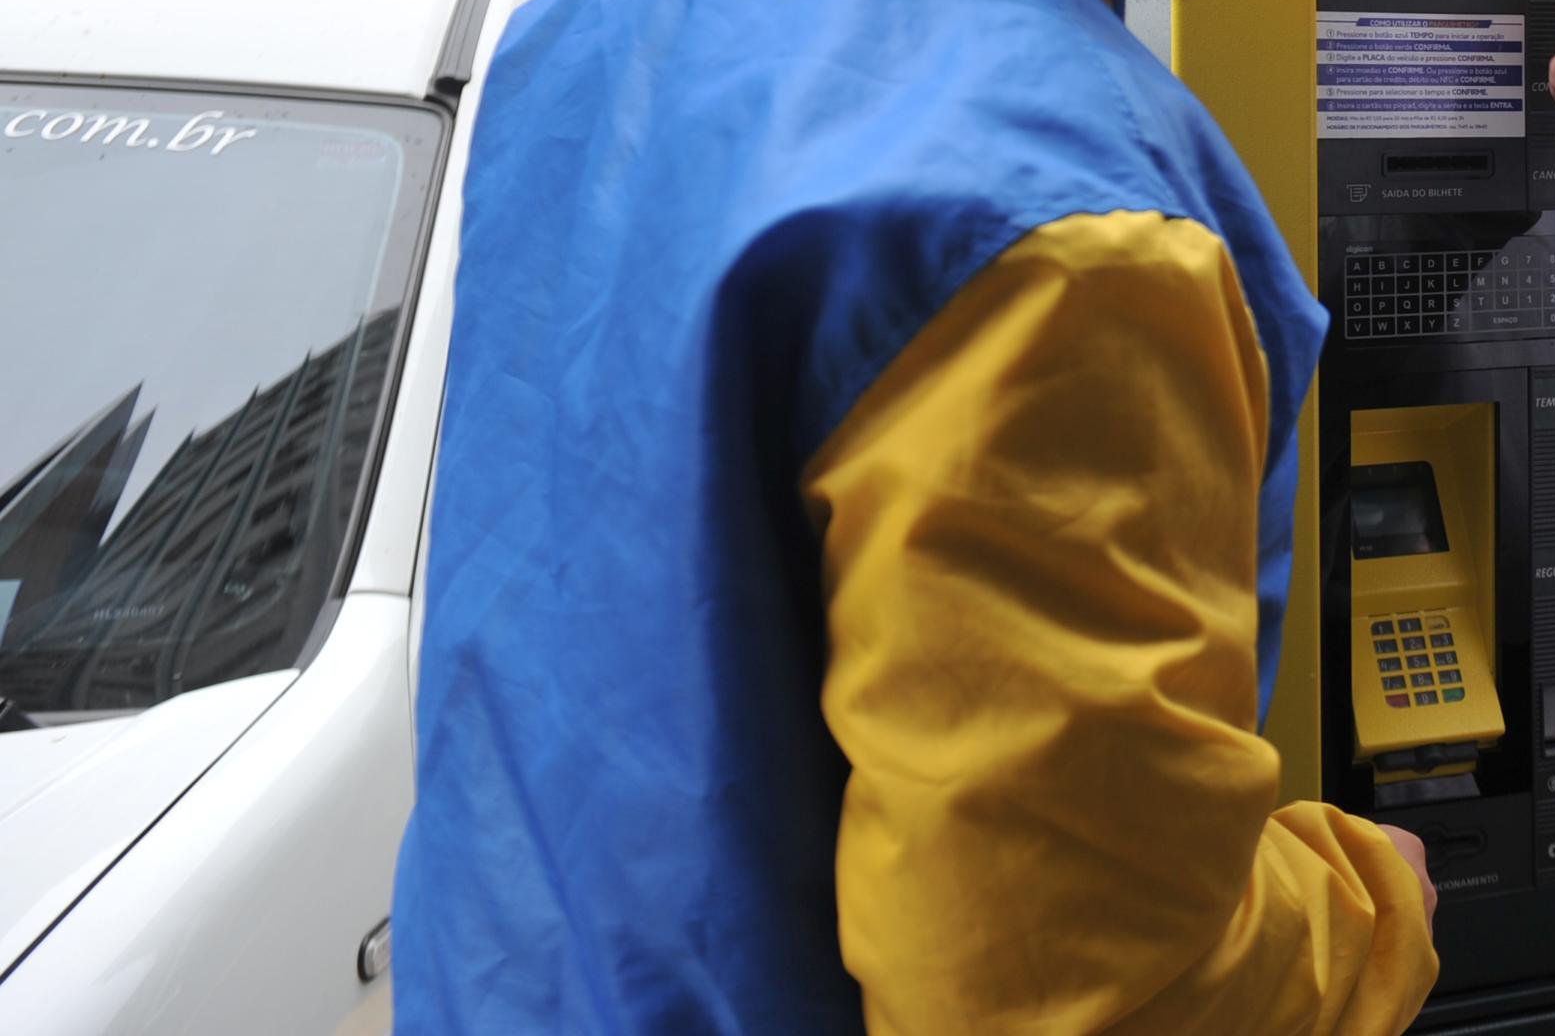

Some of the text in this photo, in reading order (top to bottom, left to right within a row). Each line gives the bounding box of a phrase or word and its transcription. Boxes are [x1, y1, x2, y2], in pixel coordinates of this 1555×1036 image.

[1336, 31, 1368, 39] Pressione
[1410, 31, 1434, 39] TEMPO
[1336, 42, 1368, 50] Pressione
[1336, 54, 1355, 63] Digite
[1362, 54, 1385, 62] PLACA
[1336, 88, 1368, 96] Pressione
[3, 109, 258, 156] com.br
[1411, 188, 1427, 198] DO
[1428, 186, 1465, 198] BILHETE
[1353, 262, 1361, 271] A
[1378, 261, 1386, 270] B
[1402, 260, 1411, 269] C
[1427, 259, 1436, 268] D
[1452, 258, 1461, 267] E
[1477, 257, 1485, 267] F
[1525, 255, 1533, 265] 7
[1353, 282, 1361, 292] H
[1404, 280, 1411, 290] J
[1427, 279, 1436, 289] K
[1452, 278, 1460, 287] L
[1477, 277, 1486, 286] M
[1501, 276, 1509, 285] N
[1525, 275, 1533, 284] 4
[1379, 301, 1387, 311] P
[1427, 299, 1436, 309] R
[1452, 298, 1461, 308] S
[1477, 297, 1485, 307] T
[1501, 296, 1509, 306] U
[1353, 323, 1362, 333] V
[1377, 321, 1389, 331] W
[1403, 320, 1412, 330] X
[1428, 318, 1436, 329] Y
[1452, 317, 1461, 327] Z
